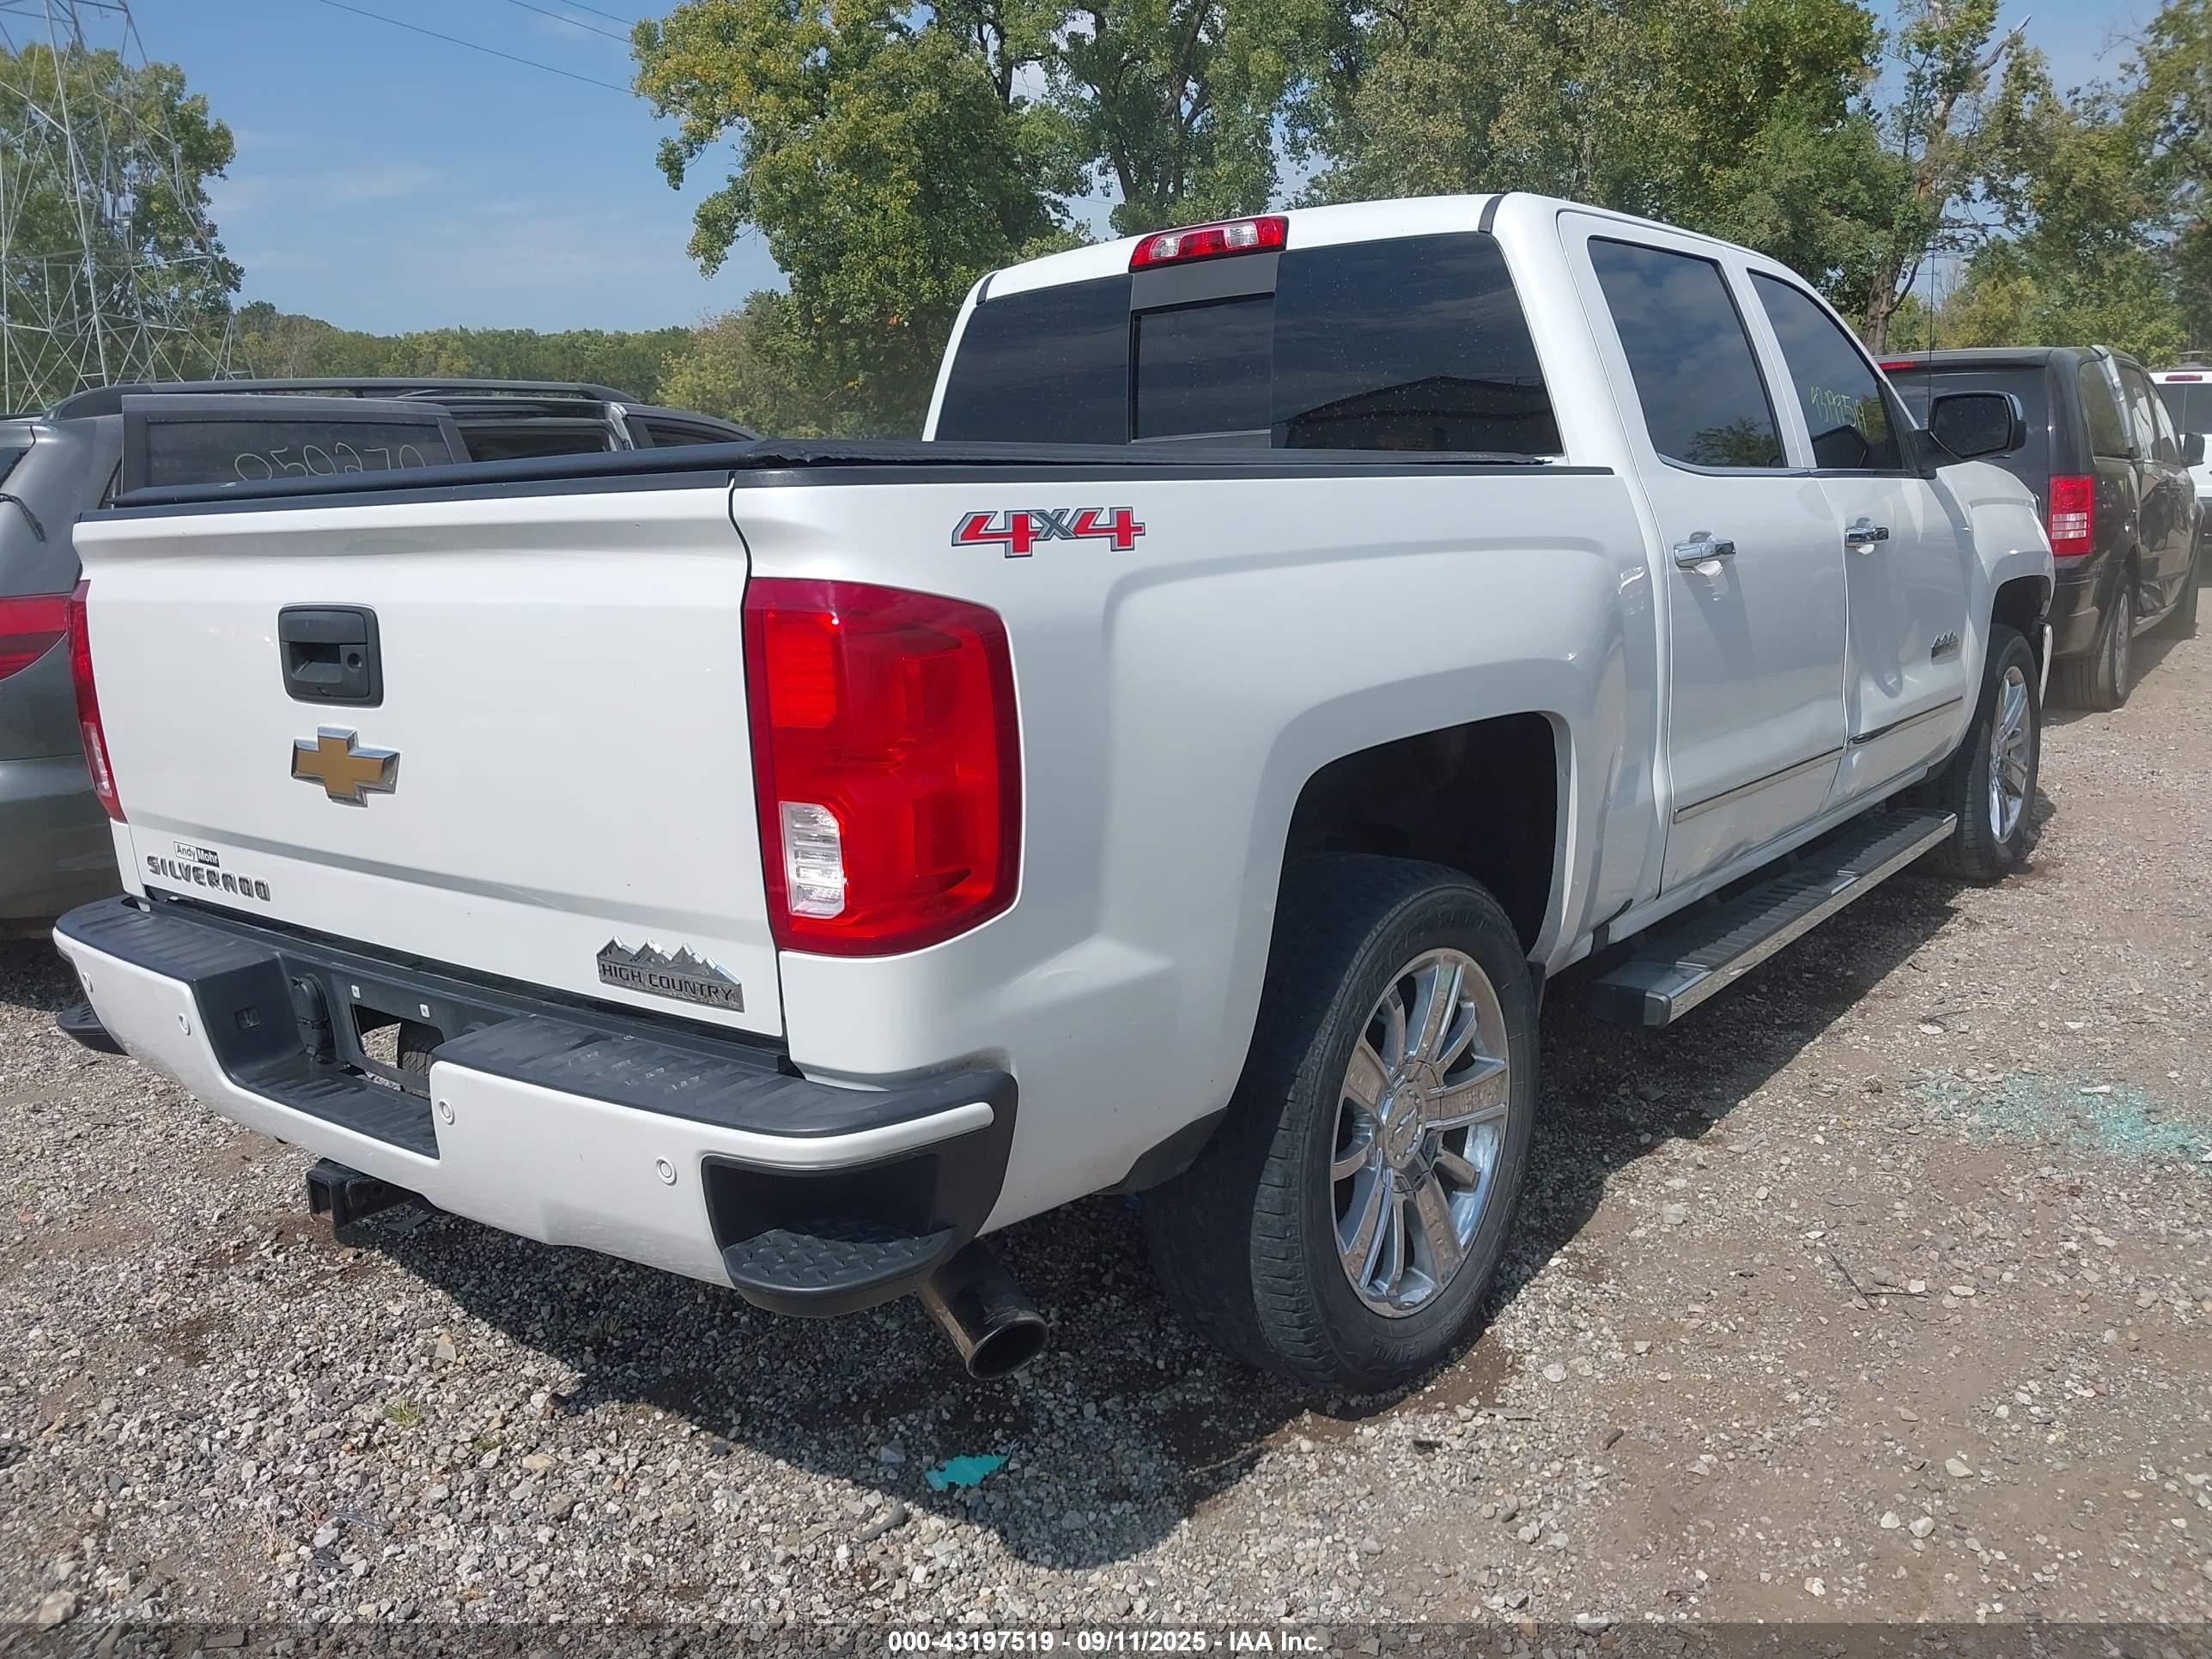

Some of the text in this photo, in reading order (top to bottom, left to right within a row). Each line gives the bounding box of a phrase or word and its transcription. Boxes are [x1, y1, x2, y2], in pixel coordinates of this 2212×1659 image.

[176, 844, 219, 864] Andy Mohr
[147, 855, 271, 902] SILVERADO
[601, 963, 732, 1001] HIGH COUNTRY
